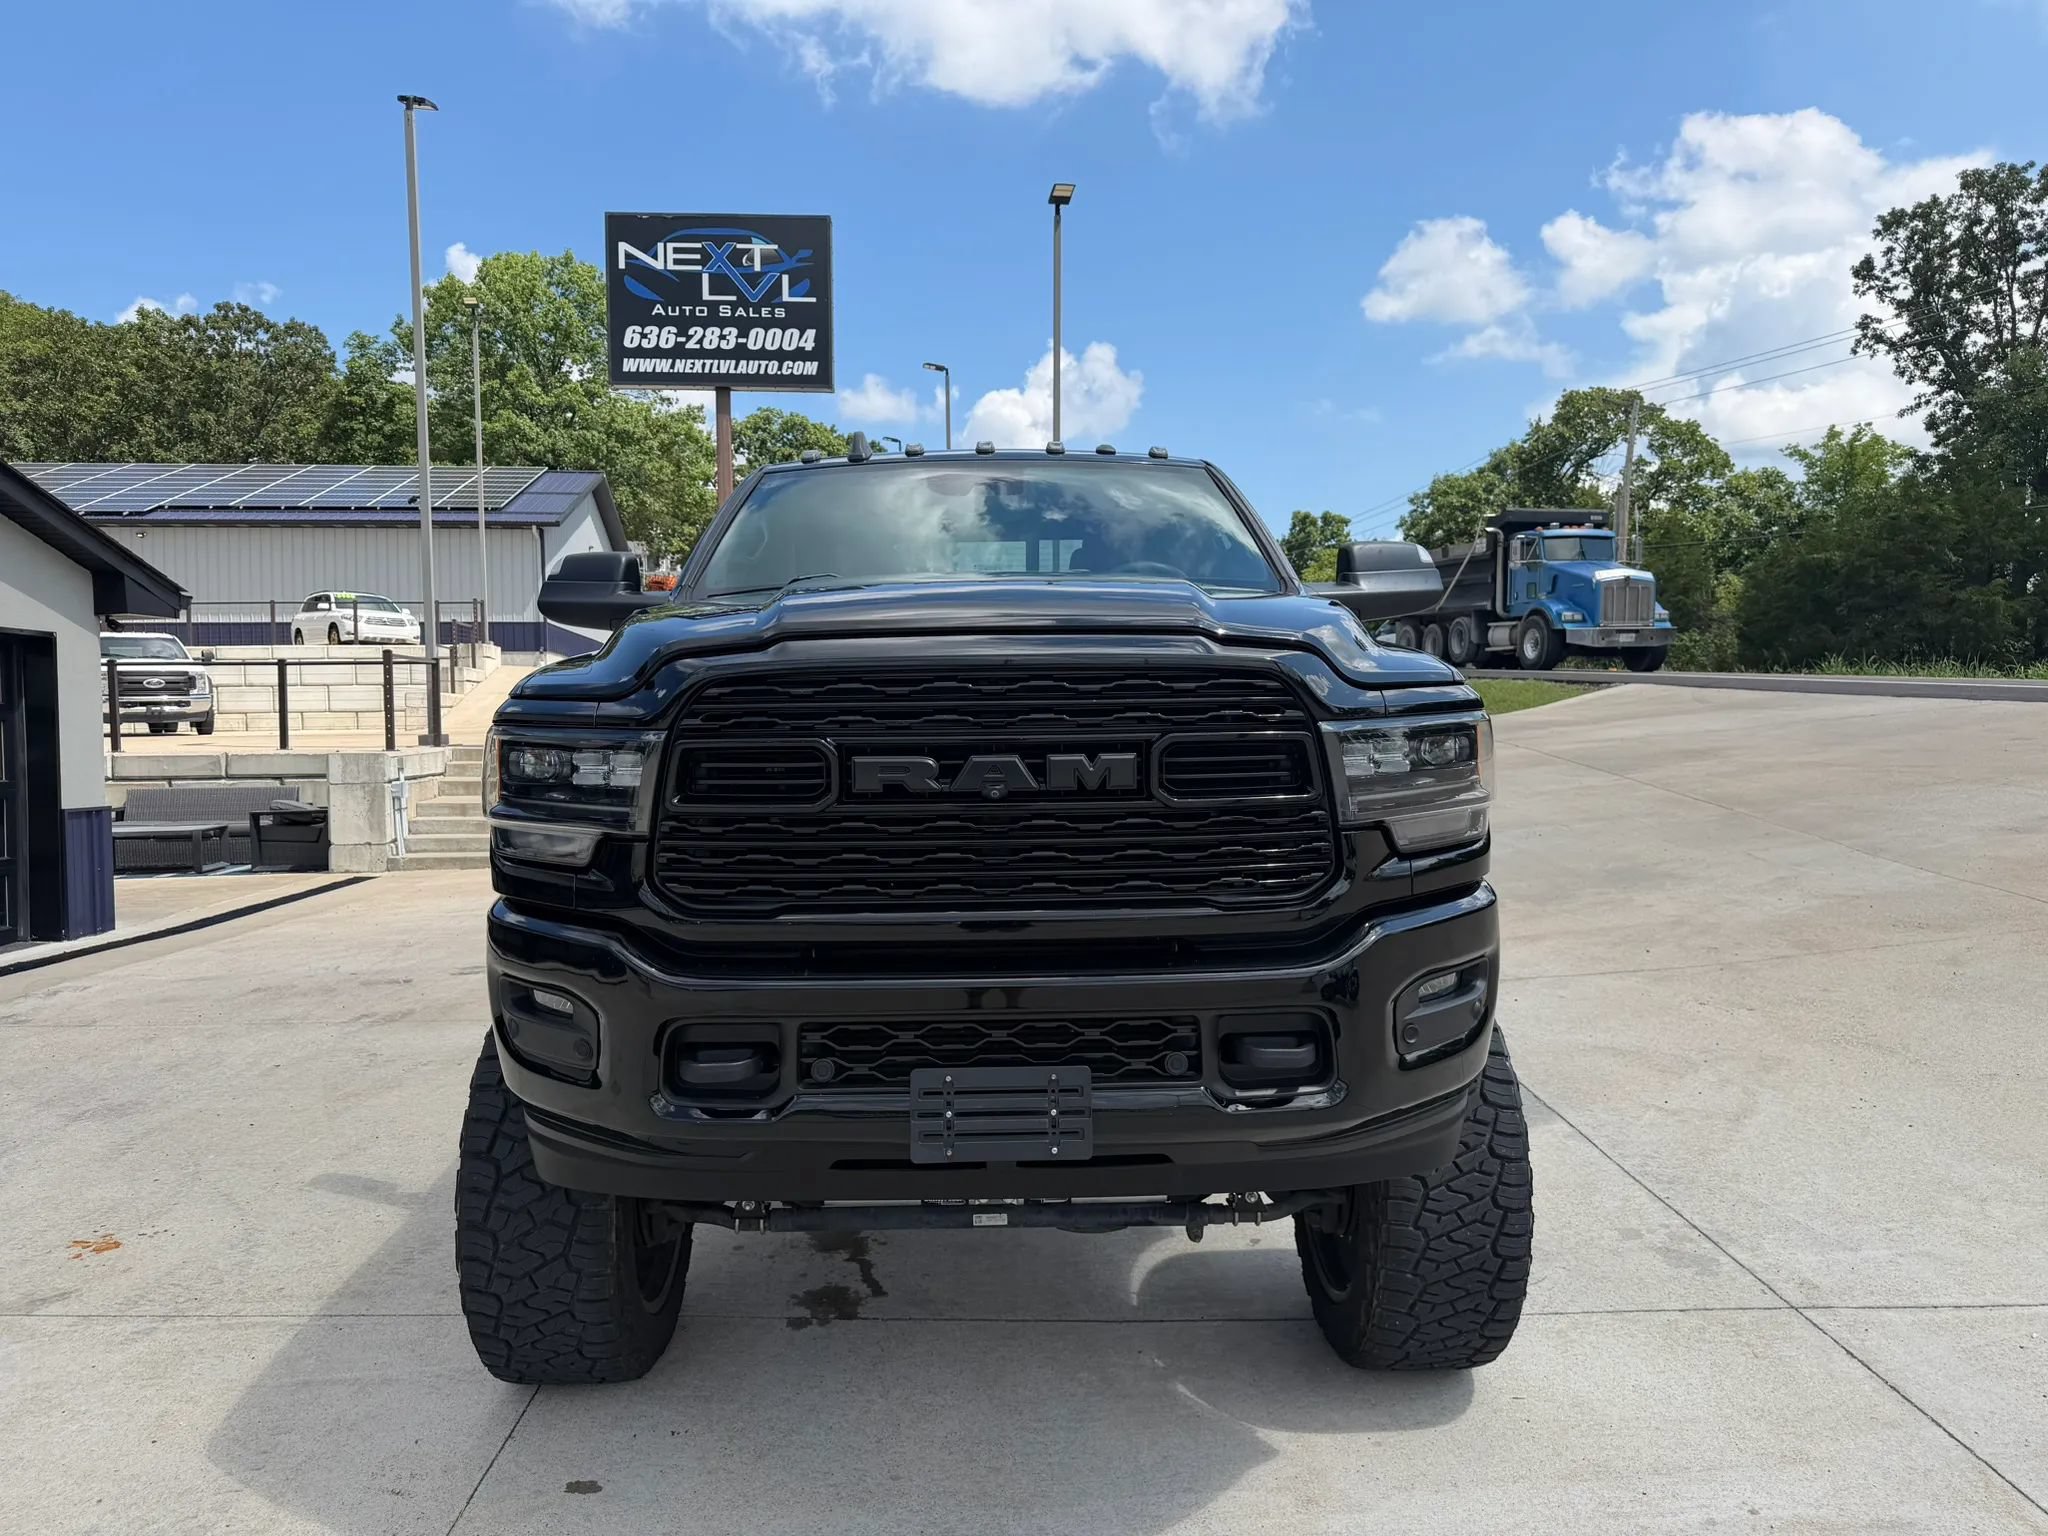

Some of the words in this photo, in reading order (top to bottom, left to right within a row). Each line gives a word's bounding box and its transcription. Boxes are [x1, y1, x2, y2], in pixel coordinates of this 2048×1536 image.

[618, 241, 778, 271] NEXT
[702, 272, 817, 302] LVL
[651, 303, 708, 317] AUTO
[719, 305, 786, 318] SALES
[623, 325, 817, 351] 636-283-0004
[622, 358, 819, 376] WWW.NEXTLVLAUTO.COM
[851, 753, 1138, 793] RAM
